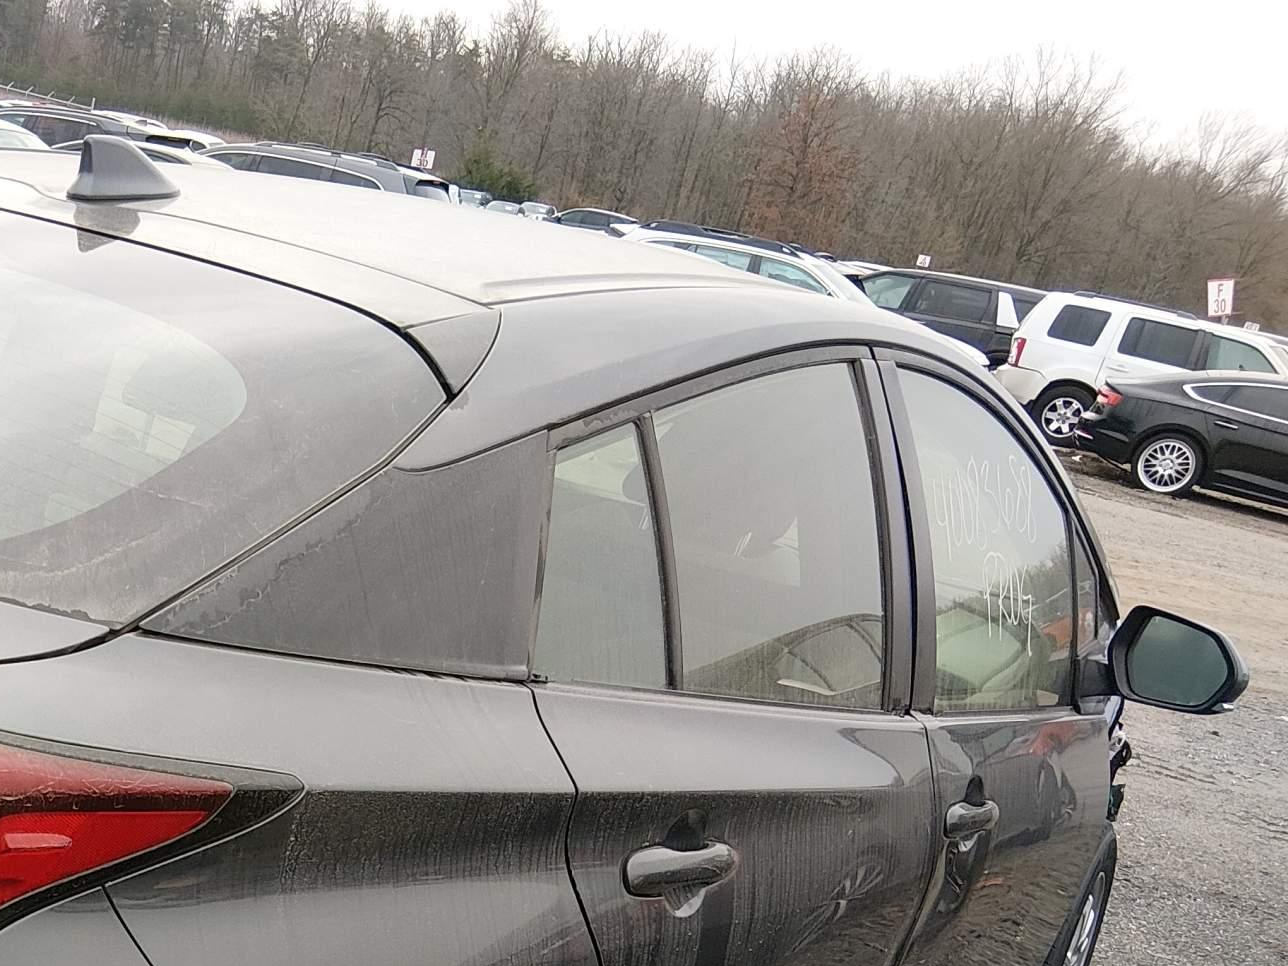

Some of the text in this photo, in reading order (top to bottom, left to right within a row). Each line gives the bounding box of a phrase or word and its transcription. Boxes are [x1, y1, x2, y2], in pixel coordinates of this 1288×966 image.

[1217, 283, 1224, 299] F
[1213, 298, 1226, 314] 30
[983, 551, 1033, 657] PROG
